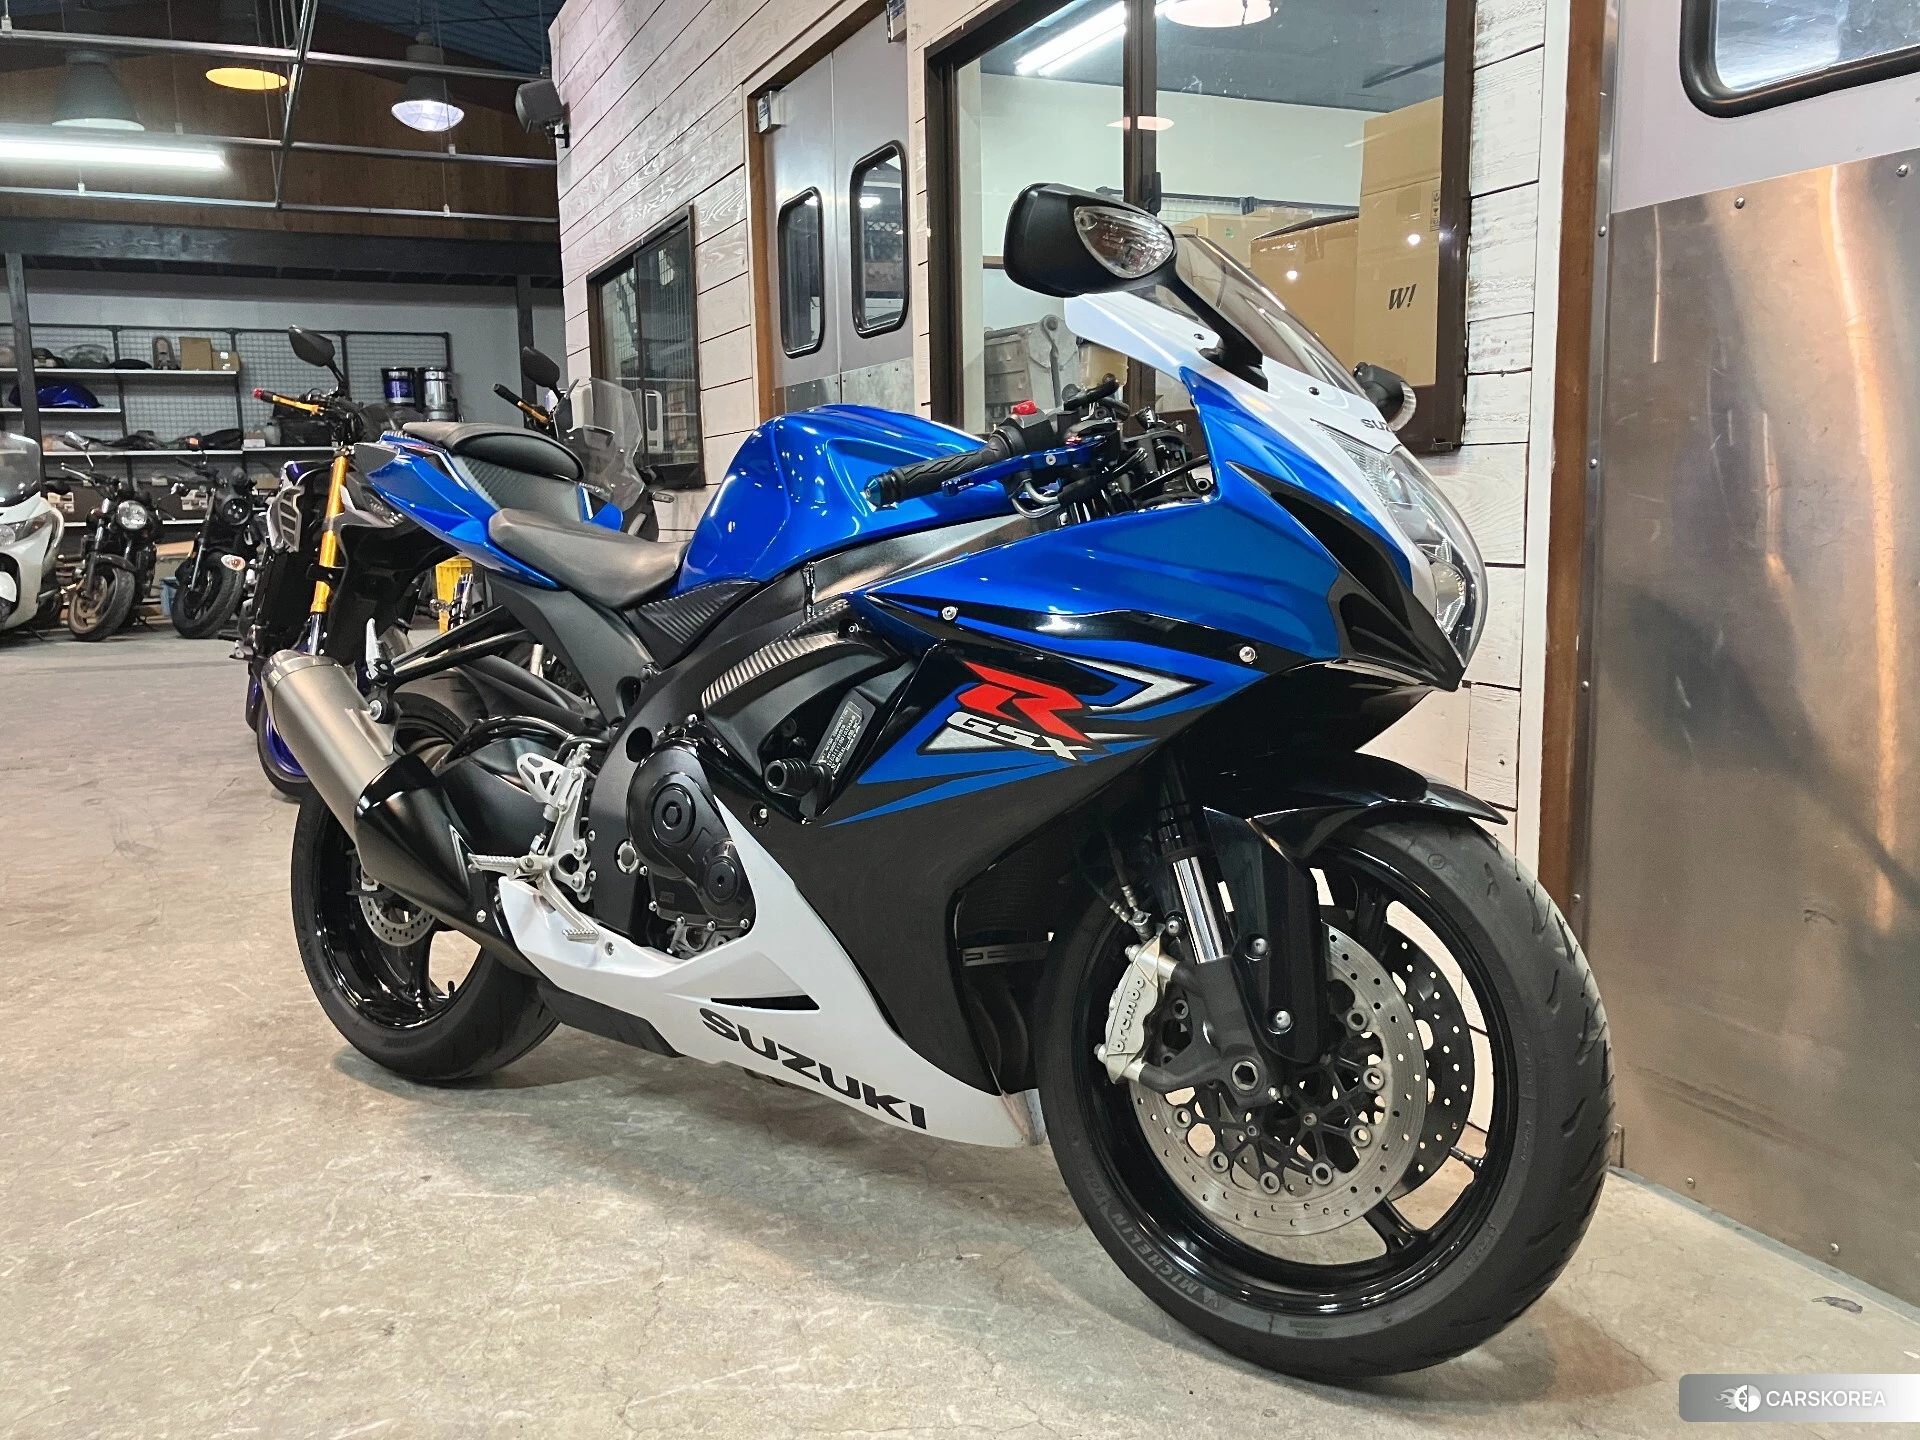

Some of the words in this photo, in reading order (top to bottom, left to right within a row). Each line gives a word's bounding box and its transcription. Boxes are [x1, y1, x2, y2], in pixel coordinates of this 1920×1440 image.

[1388, 283, 1417, 310] W!
[946, 711, 1093, 761] GSX
[957, 660, 1093, 743] R
[1112, 976, 1146, 1053] brembo
[699, 1007, 927, 1130] SUZUKI
[1111, 1211, 1200, 1296] MICHELIN
